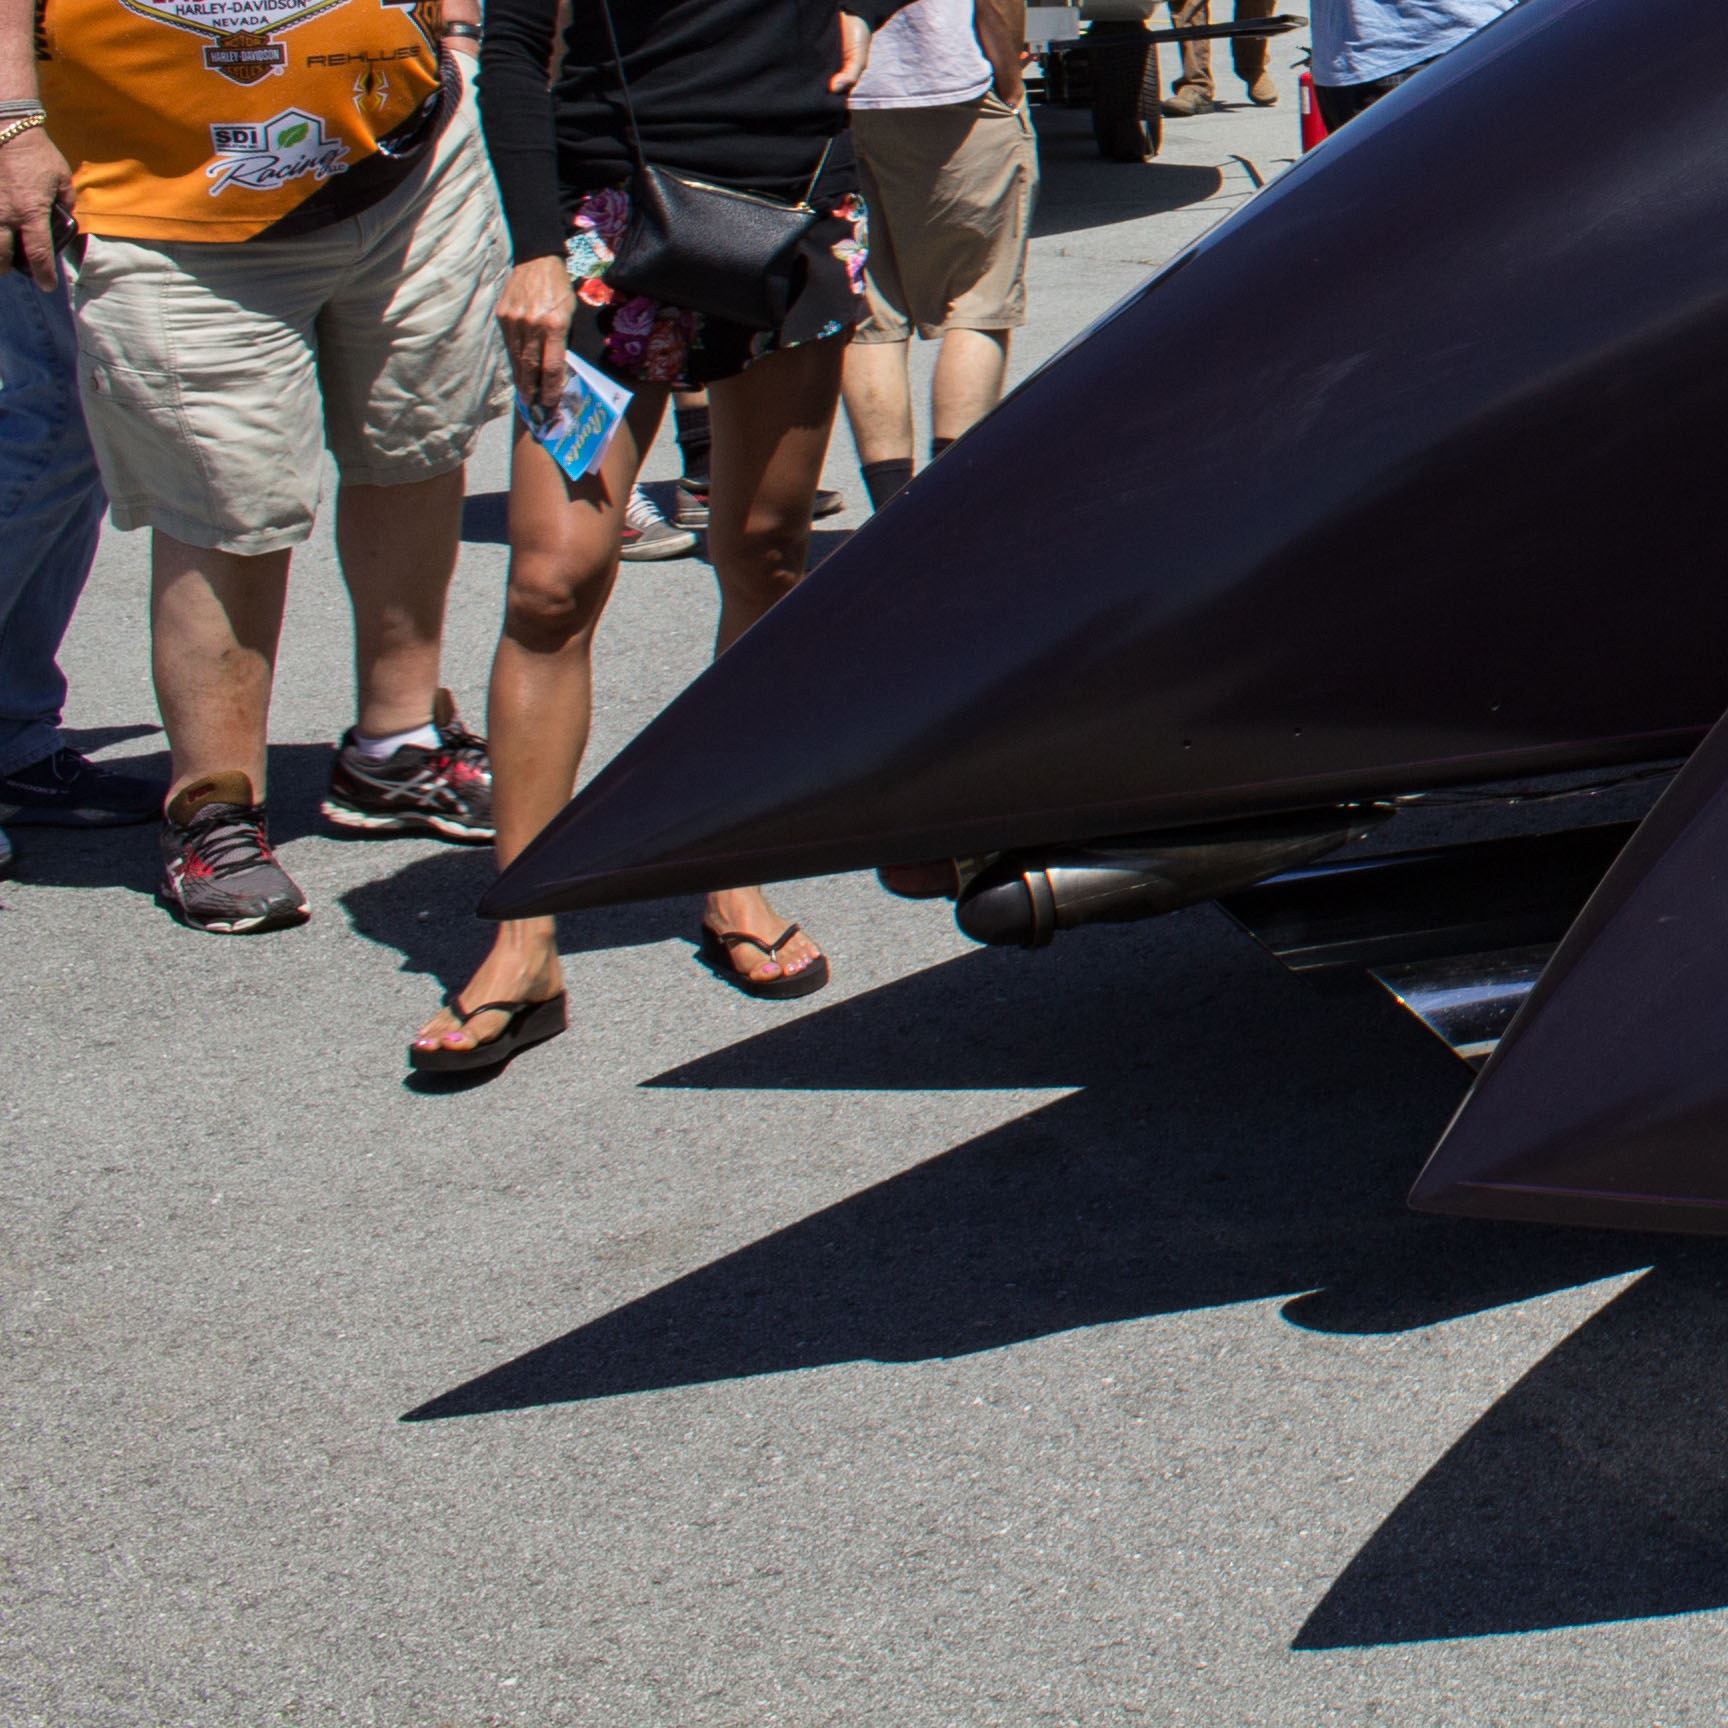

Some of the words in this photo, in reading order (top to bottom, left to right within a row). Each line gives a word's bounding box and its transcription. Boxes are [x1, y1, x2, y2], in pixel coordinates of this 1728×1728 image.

[212, 15, 270, 28] NEVADA
[216, 130, 258, 144] SDI
[208, 147, 345, 193] Racing
